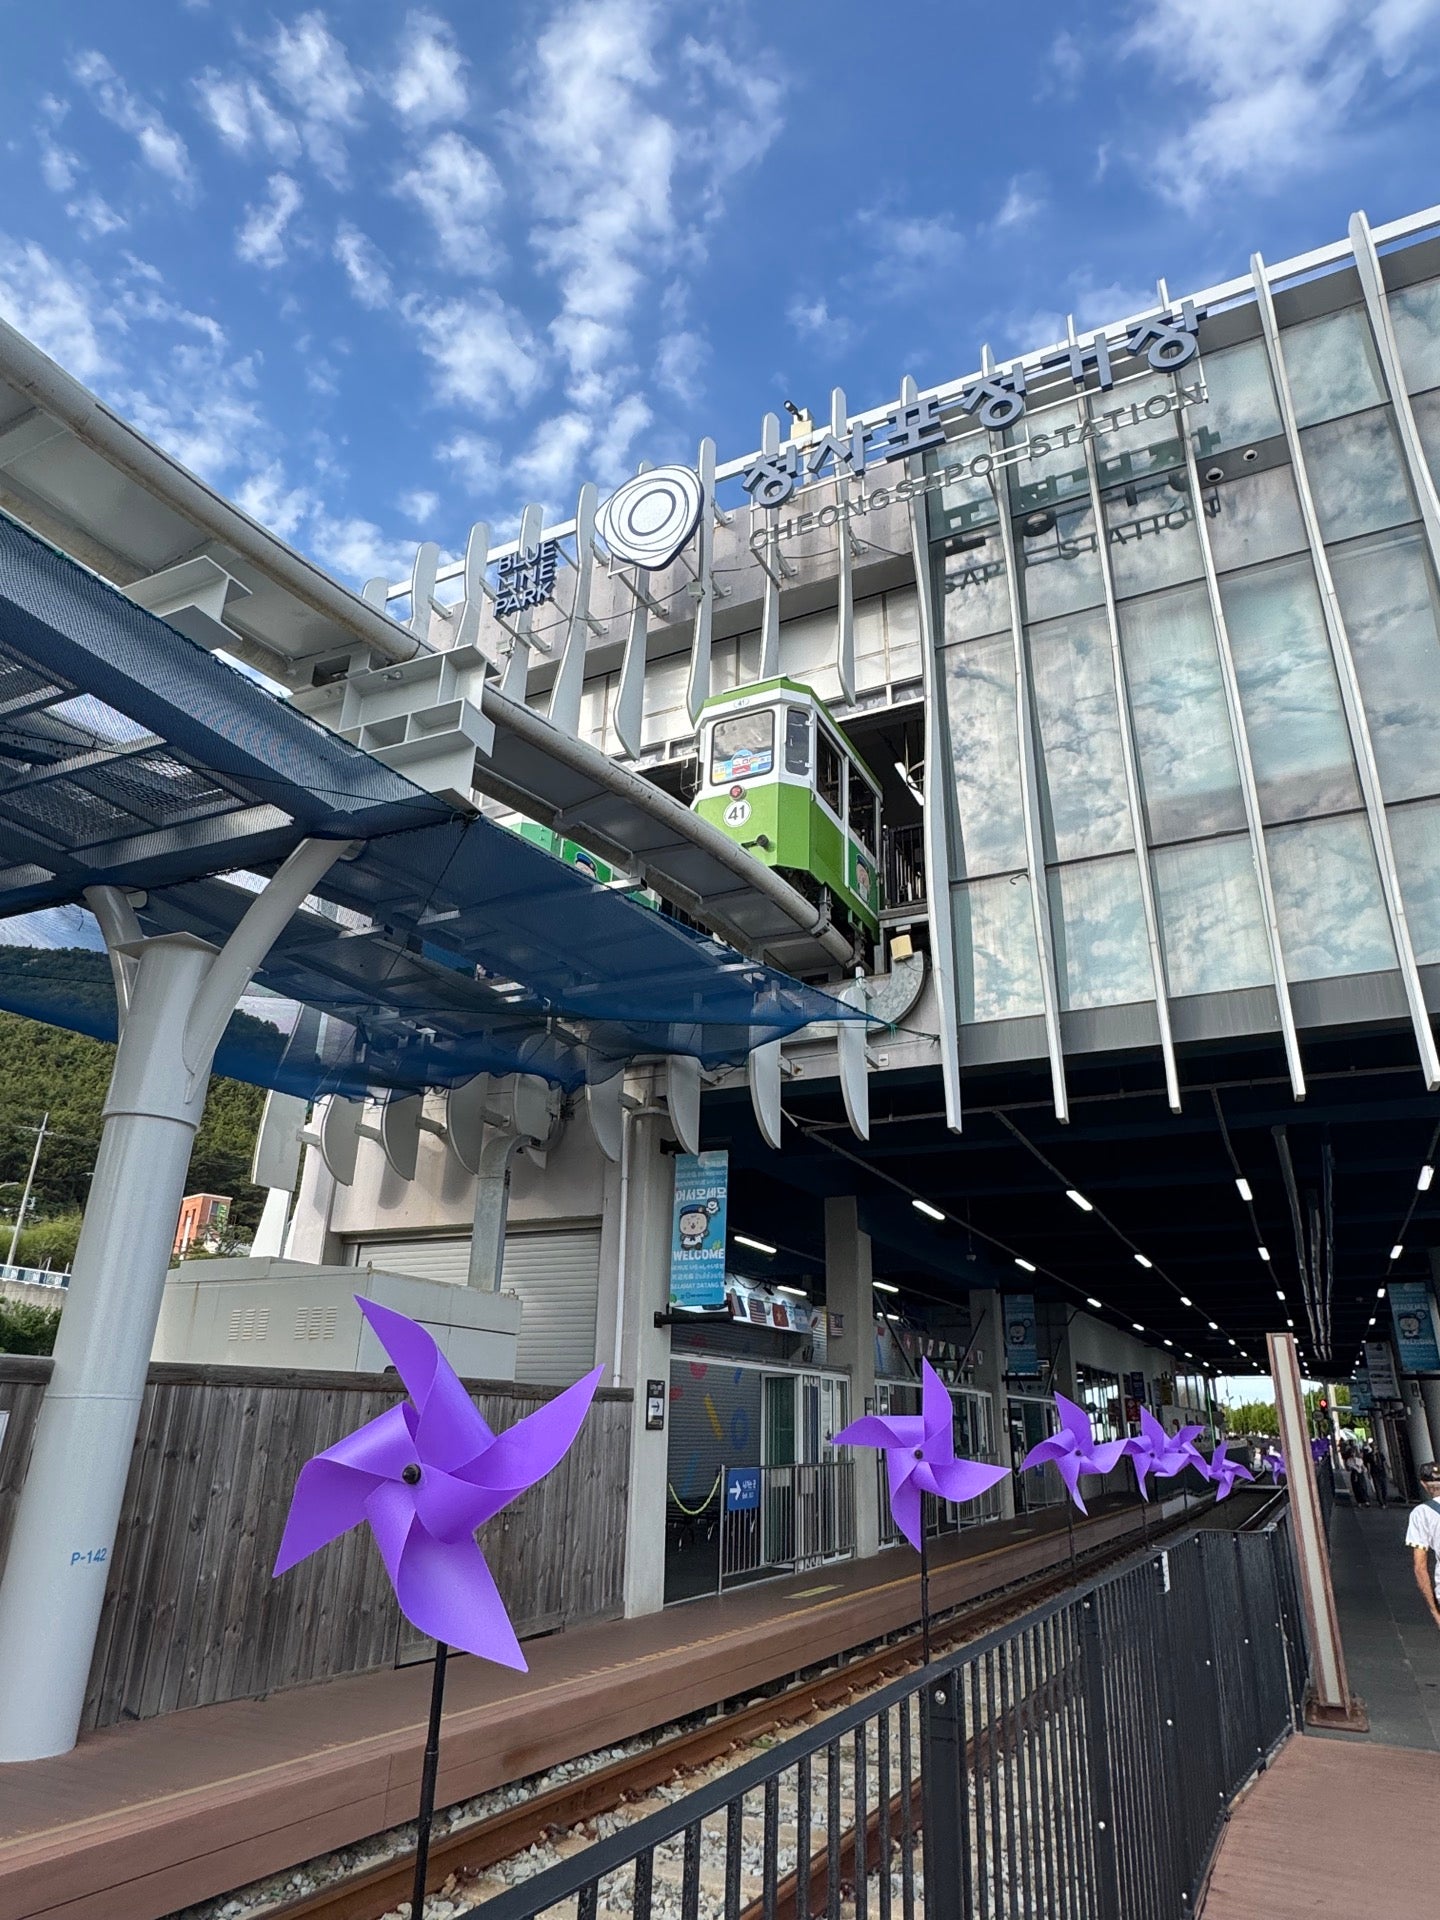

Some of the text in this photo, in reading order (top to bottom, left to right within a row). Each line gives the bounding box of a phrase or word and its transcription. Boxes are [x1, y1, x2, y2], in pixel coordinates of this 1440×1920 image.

[743, 300, 1208, 508] 청사포정거장
[750, 381, 1204, 551] CHEONGSAPO STATION
[498, 541, 557, 574] BLUE
[496, 559, 556, 598] LINE
[493, 580, 555, 617] PARK
[728, 805, 745, 820] 41
[673, 1248, 725, 1261] WELCOME
[71, 1547, 107, 1566] P-142
